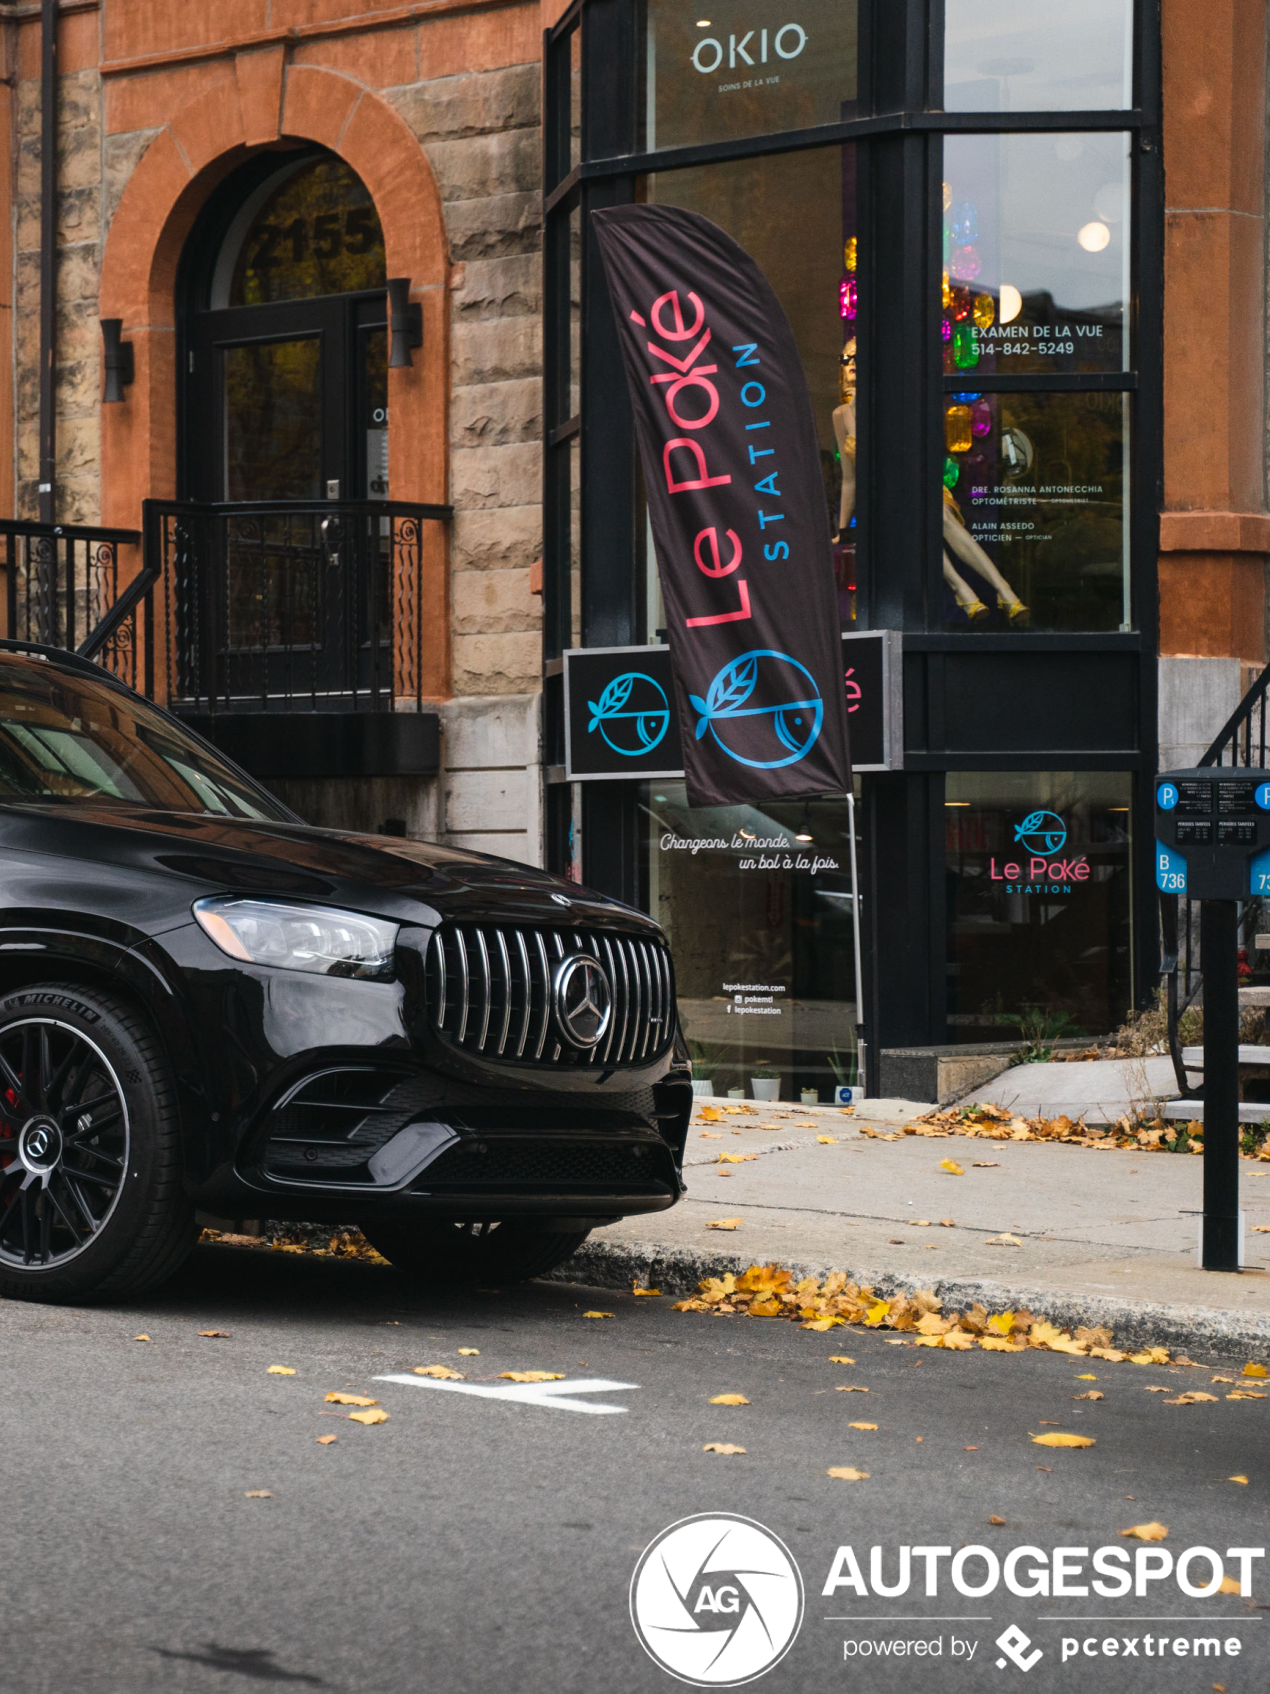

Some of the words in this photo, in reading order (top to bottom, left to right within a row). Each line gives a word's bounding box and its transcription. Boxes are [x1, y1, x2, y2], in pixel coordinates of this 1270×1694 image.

[690, 23, 809, 74] OKIO
[718, 82, 741, 93] SOINS
[743, 80, 753, 89] DE
[754, 78, 764, 87] LA
[766, 75, 780, 84] VUE
[252, 208, 376, 269] 2155
[971, 326, 1029, 339] EXAMEN
[1033, 325, 1051, 338] DE
[1055, 325, 1072, 338] LA
[1075, 325, 1103, 338] VUE
[971, 342, 1074, 355] 514-842-5249
[733, 343, 789, 560] STATION
[972, 486, 991, 494] DRE.
[993, 486, 1036, 494] ROSANNA
[1039, 485, 1103, 493] ANTONECCHIA
[972, 497, 1037, 505] OPTOMÉTRISTE
[972, 522, 997, 530] ALAIN
[999, 522, 1035, 530] ASSEDO
[972, 534, 1012, 542] OPTICIEN
[686, 526, 752, 628] Le
[660, 833, 729, 855] Changeons
[730, 833, 744, 849] le
[739, 859, 757, 870] un
[758, 854, 781, 870] bol
[782, 854, 794, 870] à
[795, 854, 811, 870] la
[811, 856, 840, 875] fois.
[990, 857, 1020, 880] Le
[1159, 854, 1170, 870] B
[1160, 873, 1185, 889] 736
[1006, 885, 1071, 894] STATION
[722, 983, 786, 993] lepokestation.com
[24, 994, 98, 1021] MICHELIN
[744, 995, 774, 1004] pokemtl
[734, 1006, 781, 1016] lepokestation
